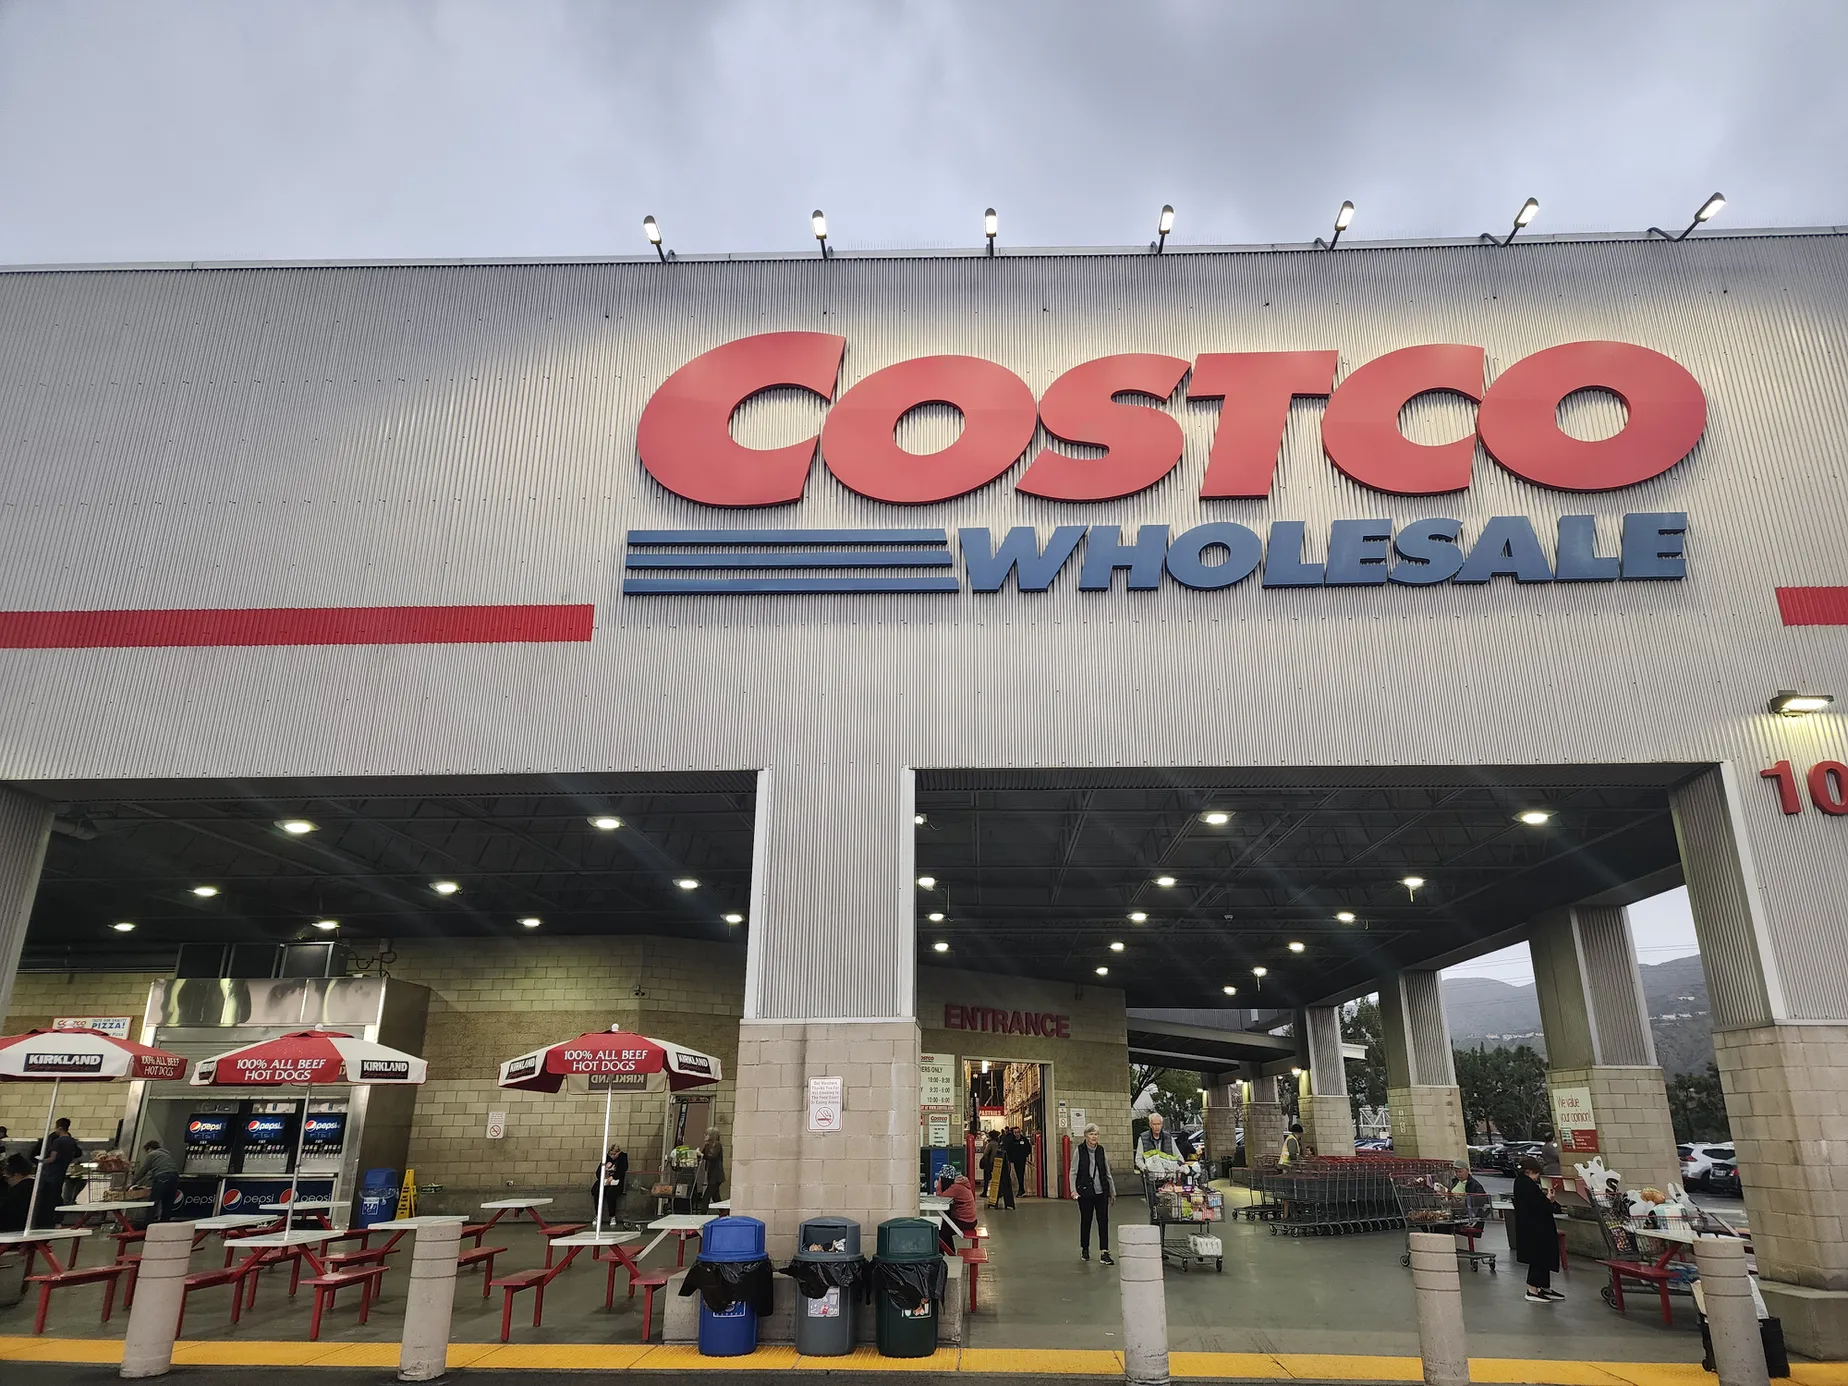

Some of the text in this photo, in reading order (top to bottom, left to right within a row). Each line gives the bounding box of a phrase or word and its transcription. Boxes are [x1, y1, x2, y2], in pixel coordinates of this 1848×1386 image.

[636, 331, 1707, 508] COSTCO
[959, 511, 1688, 594] WHOLESALE
[944, 1004, 1071, 1038] ENTRANCE
[28, 1054, 101, 1065] KIRKLAND
[564, 1050, 648, 1060] 100% ALL BEEF
[678, 1053, 709, 1068] KIRKLAND
[156, 1056, 167, 1066] ALL
[168, 1057, 180, 1067] BEEF
[237, 1059, 326, 1069] 100% ALL BEEF
[363, 1061, 408, 1072] KIRKLAND
[509, 1058, 537, 1073] KIRKLAND
[573, 1060, 636, 1071] HOT DOGS
[144, 1067, 174, 1077] HOT DOGS
[244, 1070, 312, 1081] HOT DOGS
[1567, 1094, 1580, 1108] value
[200, 1122, 222, 1132] pepsi
[259, 1121, 280, 1132] pepsi
[316, 1121, 338, 1131] pepsi
[185, 1194, 217, 1205] pepsi
[244, 1193, 275, 1205] pepsi
